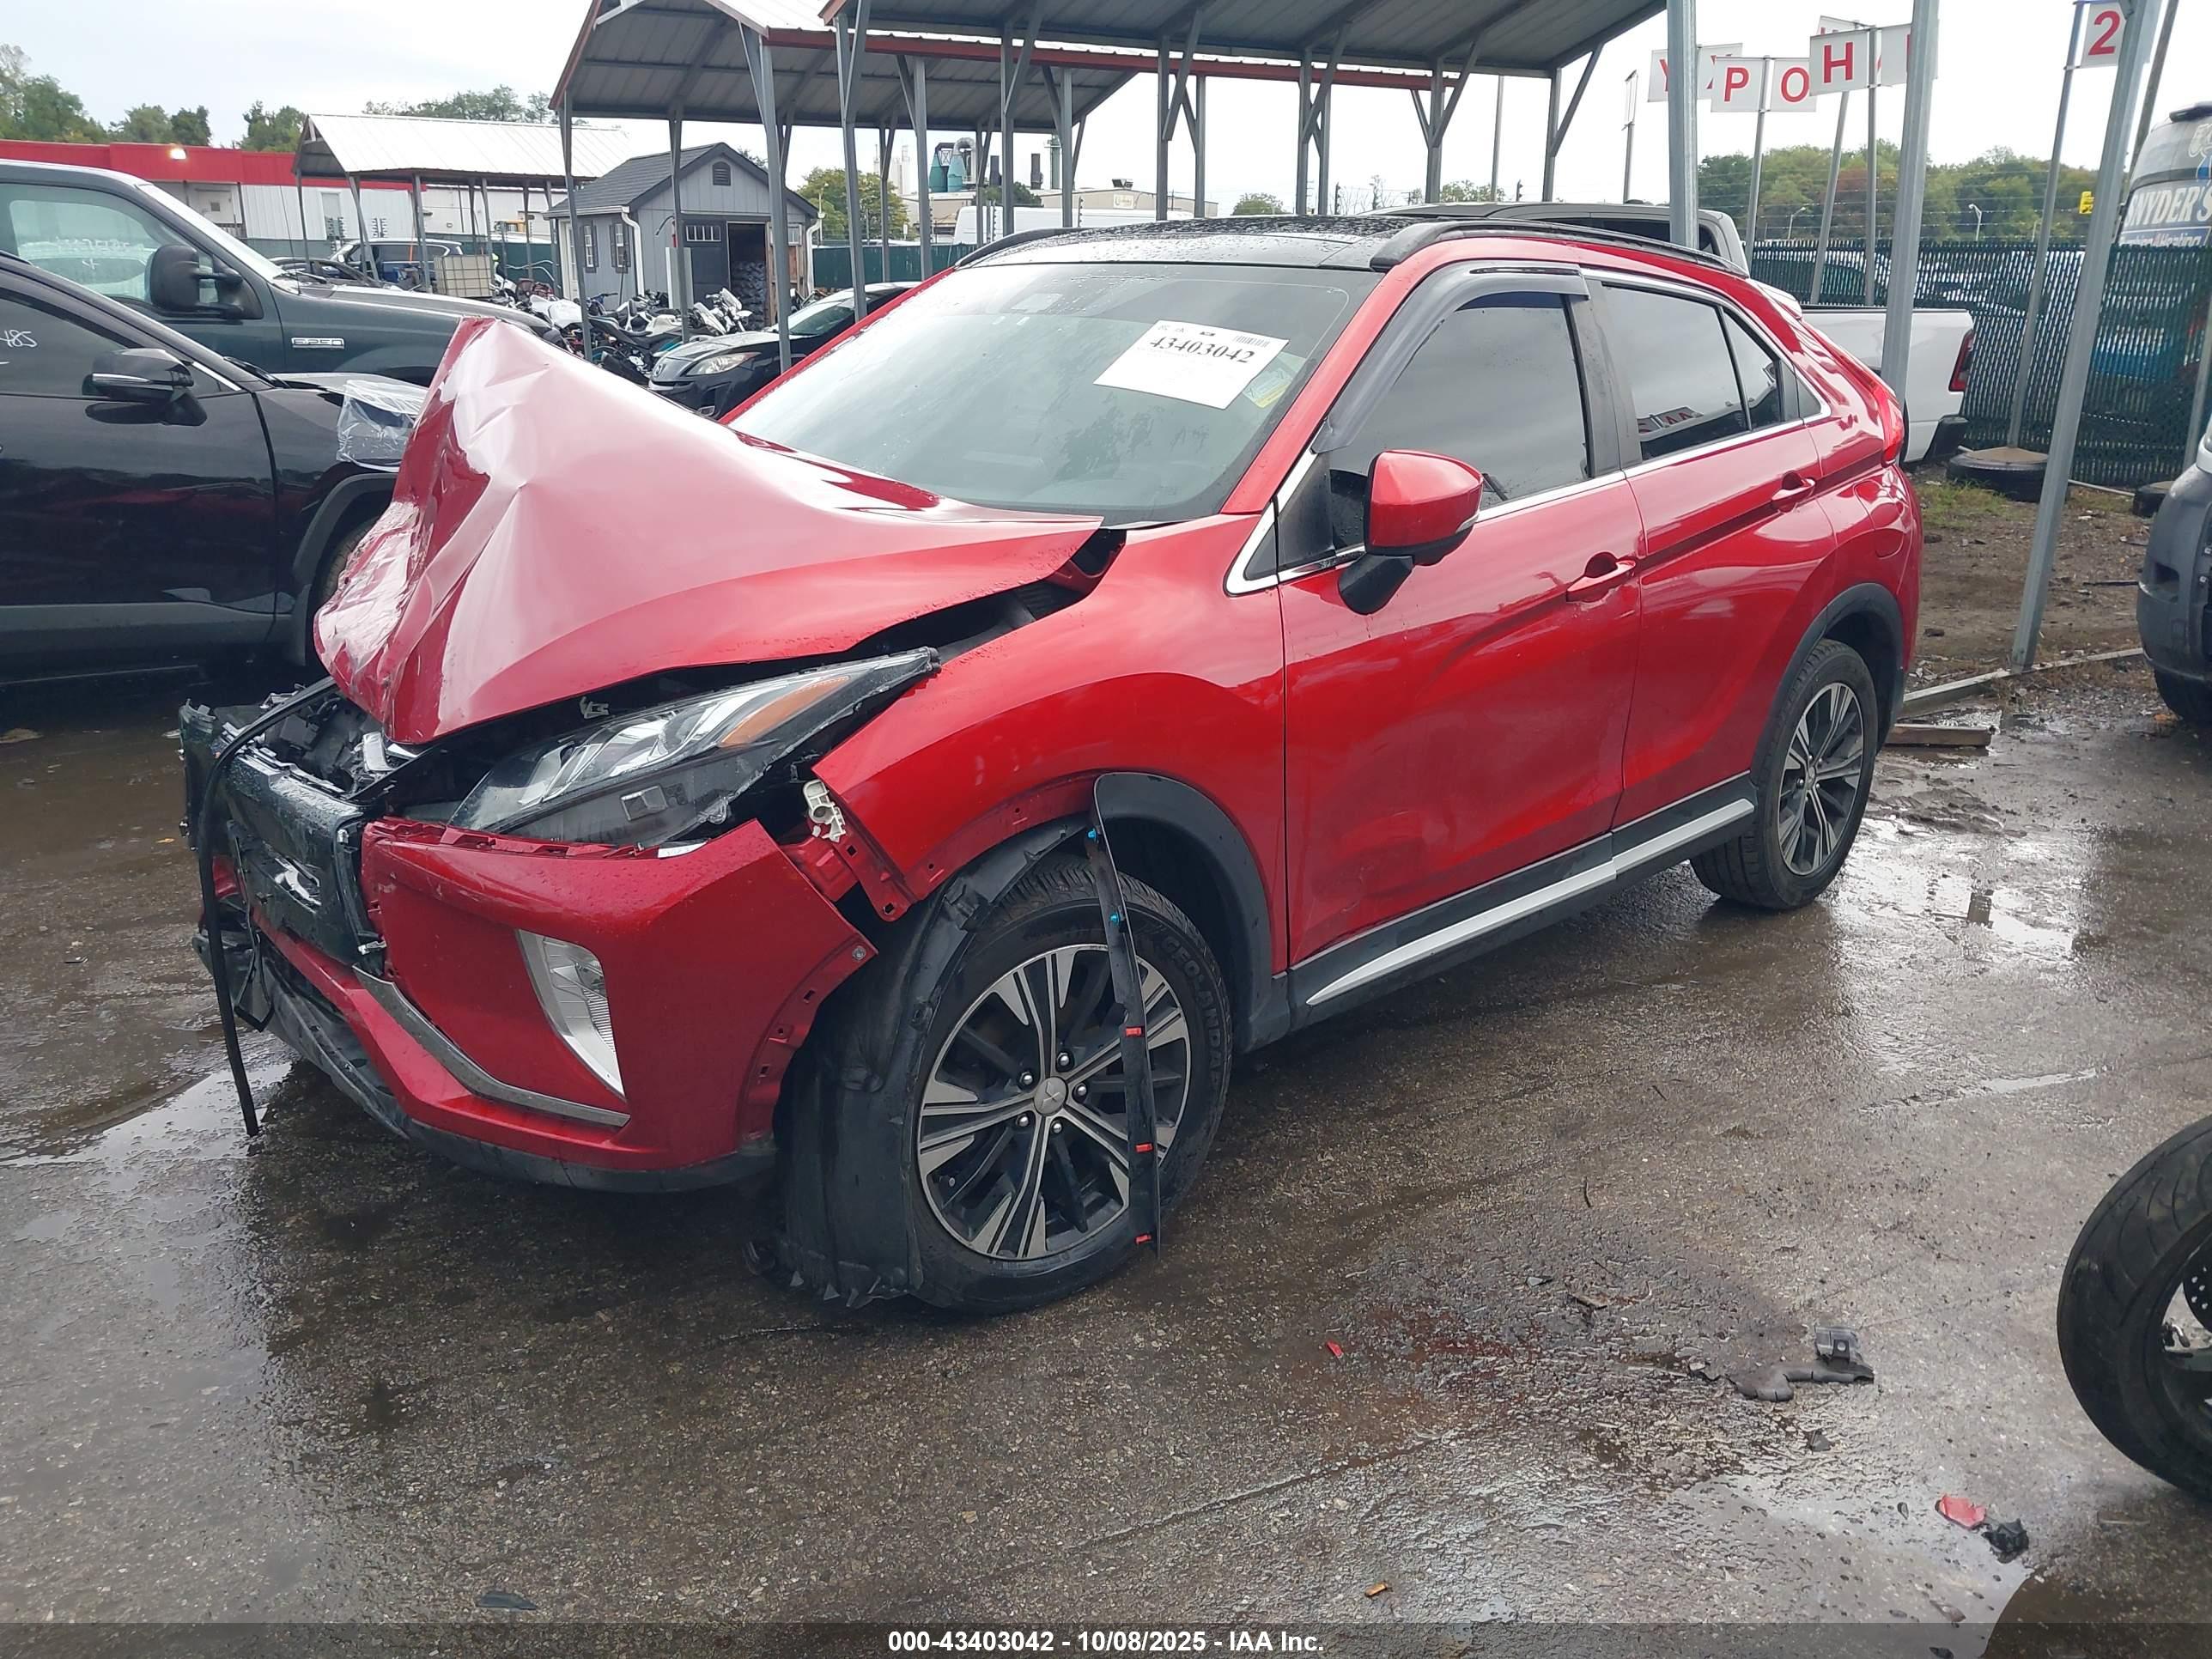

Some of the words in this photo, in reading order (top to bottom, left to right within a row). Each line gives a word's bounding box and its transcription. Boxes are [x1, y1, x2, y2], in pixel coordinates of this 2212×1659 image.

[2088, 10, 2120, 56] 2
[1824, 41, 1853, 83] H
[1724, 67, 1749, 102] P
[1780, 66, 1810, 102] O
[1149, 336, 1255, 363] 43403042
